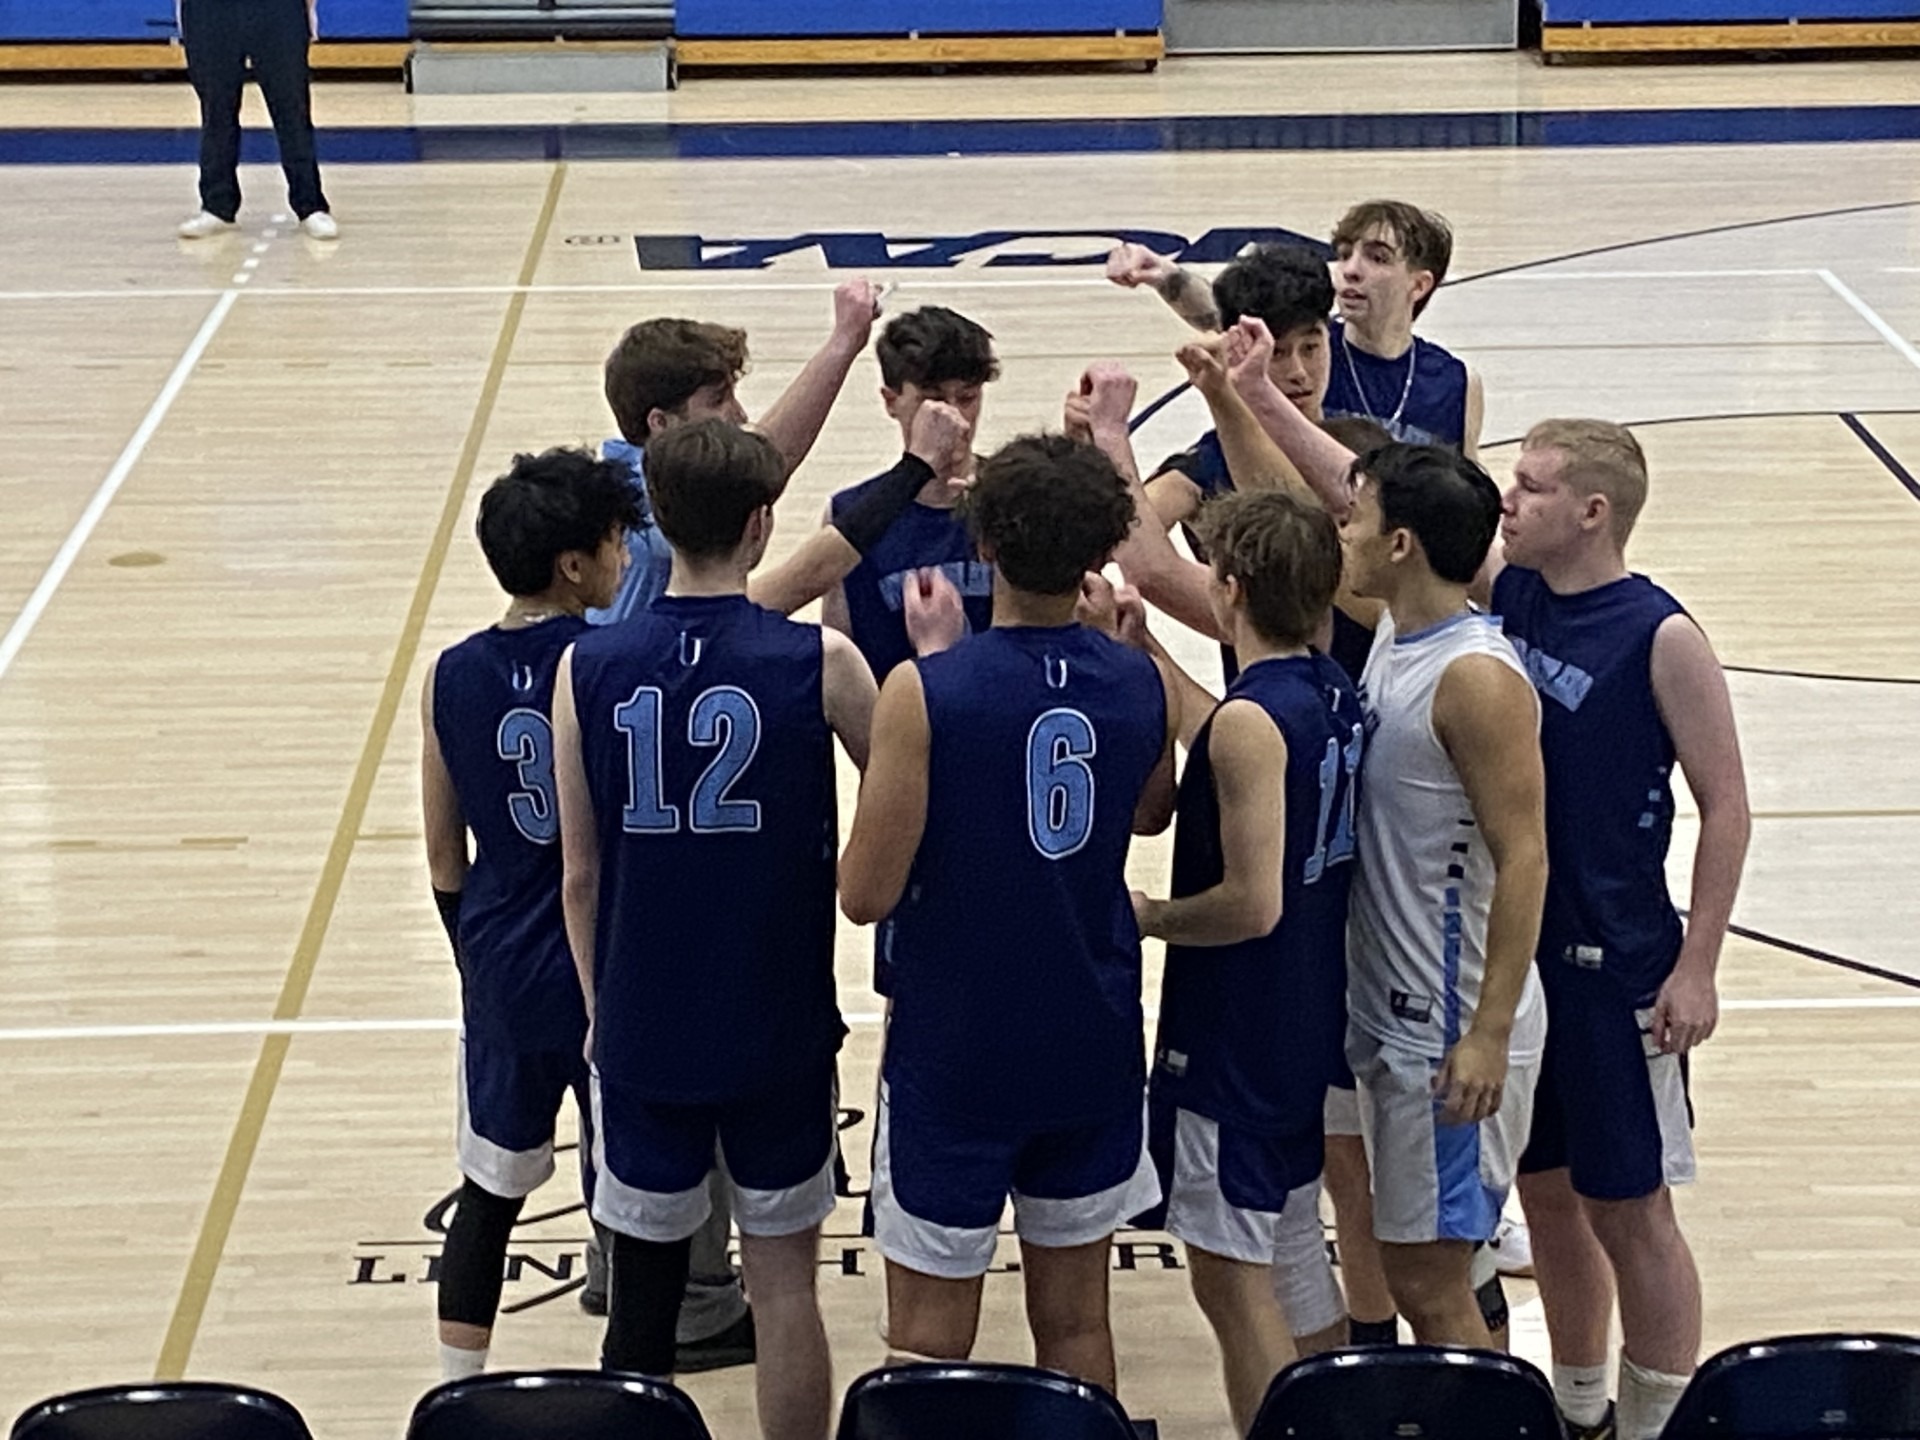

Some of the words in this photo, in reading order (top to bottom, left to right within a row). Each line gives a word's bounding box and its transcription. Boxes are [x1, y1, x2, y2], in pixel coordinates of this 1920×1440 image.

[497, 708, 557, 845] 3
[614, 685, 761, 833] 12
[1026, 708, 1096, 860] 6
